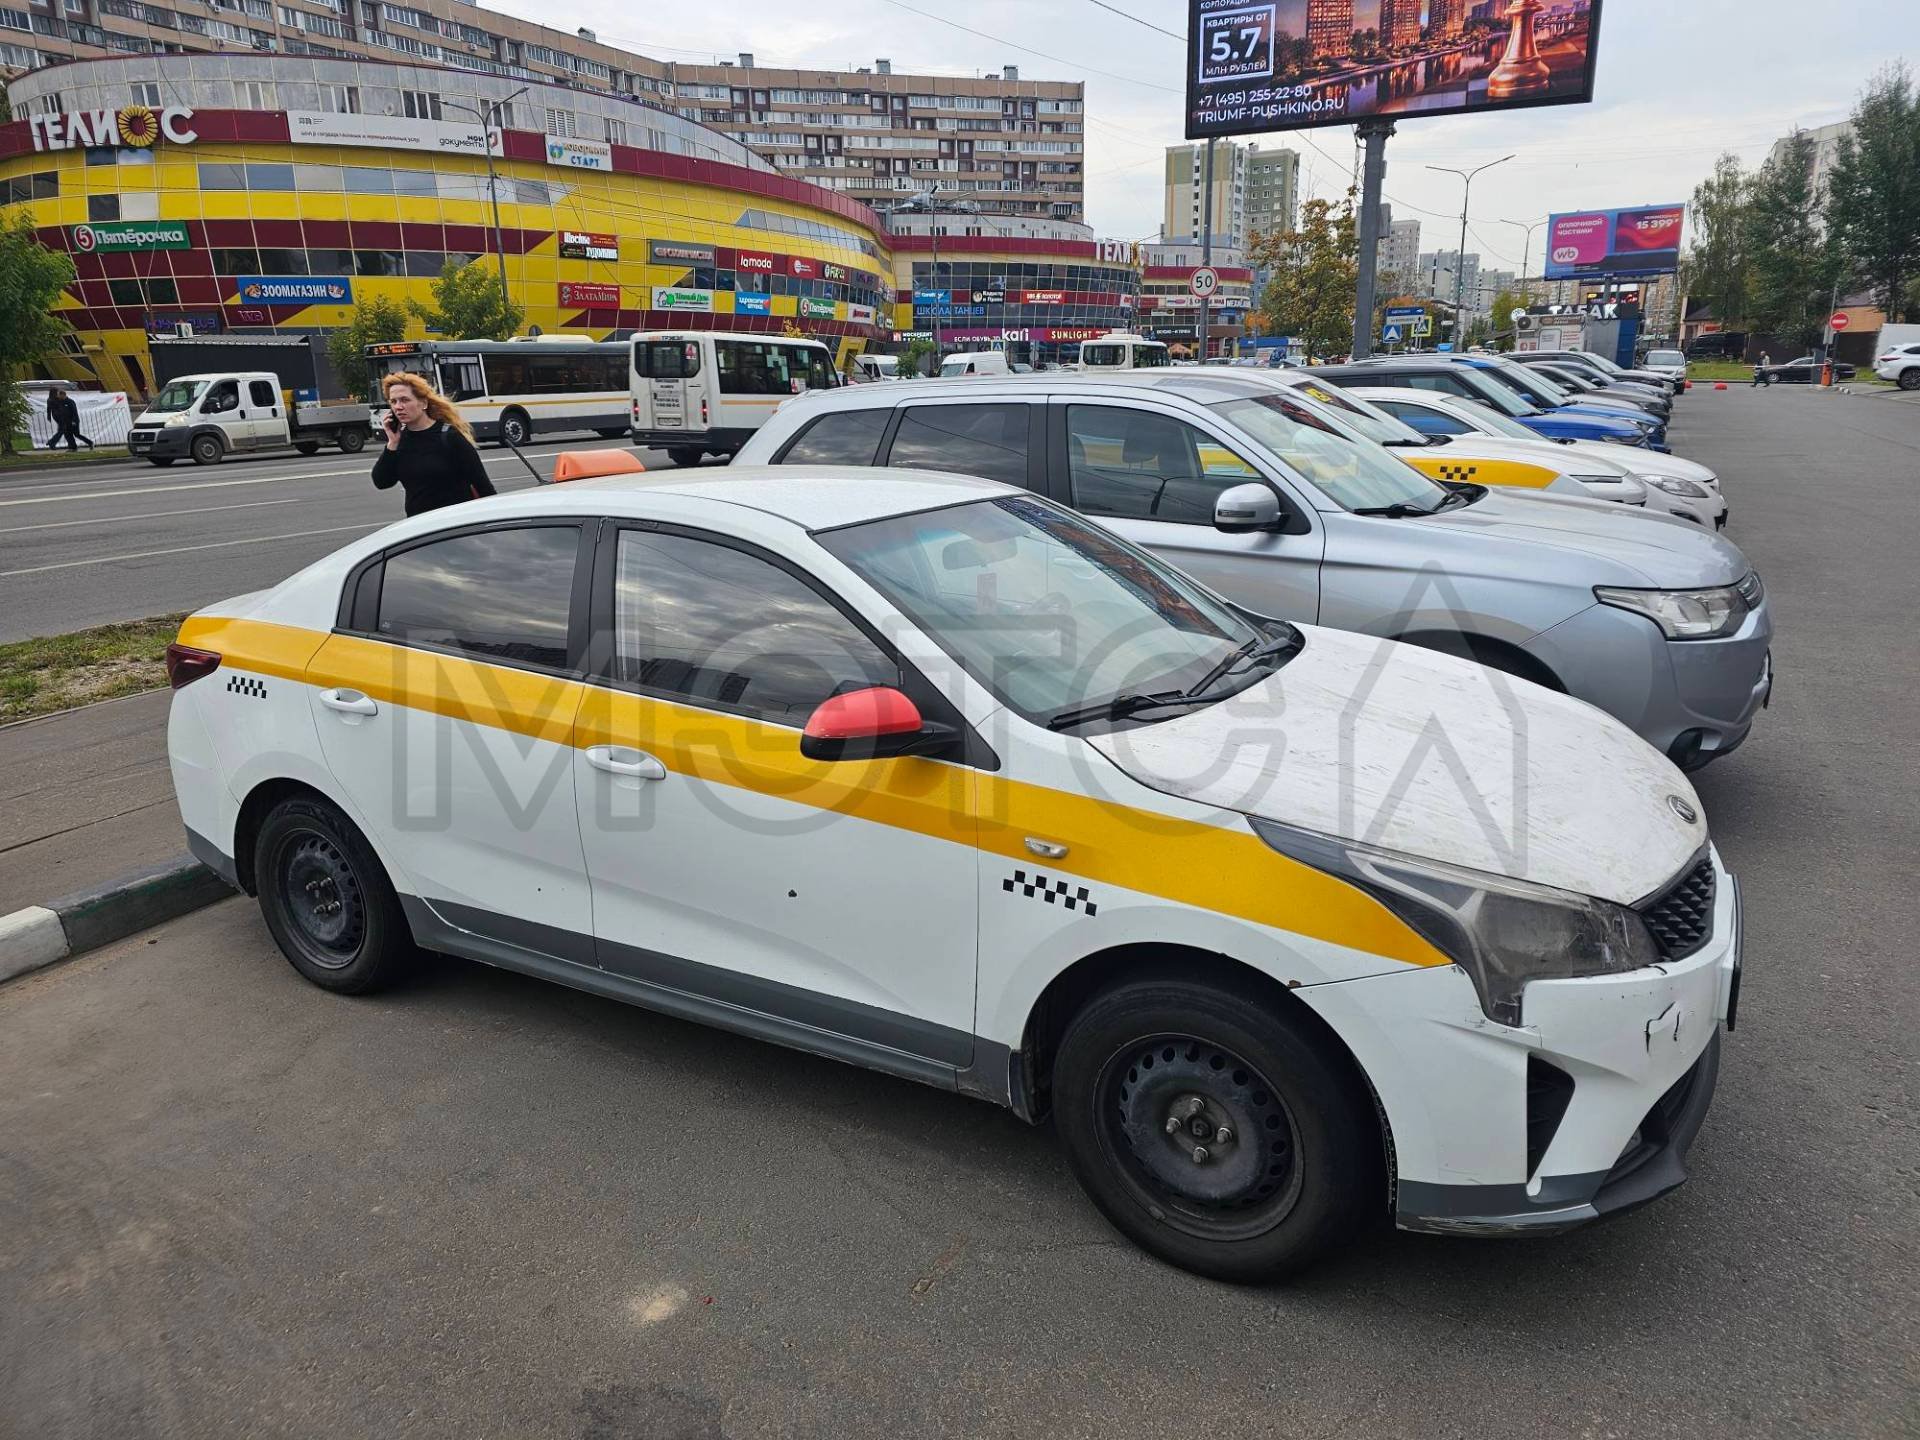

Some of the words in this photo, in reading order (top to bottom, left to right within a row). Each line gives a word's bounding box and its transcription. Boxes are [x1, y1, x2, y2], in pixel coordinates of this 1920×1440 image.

[1207, 15, 1254, 28] КВАРТИРЫ
[1255, 13, 1268, 22] ОТ
[1210, 27, 1263, 62] 5.7
[1206, 66, 1227, 76] МЛН
[1229, 58, 1267, 74] РУБЛЕЙ
[1198, 95, 1213, 107] +7
[1215, 90, 1246, 107] (495)
[1248, 84, 1312, 102] 255-22-80
[1198, 97, 1345, 123] TRIUMF-PUSHKINO.RU
[29, 105, 198, 151] ГЕЛИОС
[570, 155, 600, 168] СТАРТ
[1636, 220, 1649, 230] 15
[1650, 218, 1673, 228] 399
[95, 228, 185, 247] Пятёрочка
[740, 254, 772, 269] lamoda
[1556, 249, 1576, 260] wb
[1195, 276, 1213, 288] 50
[261, 284, 327, 297] ЗООМАГАЗИН
[916, 306, 950, 316] ШКОЛА
[953, 306, 985, 316] ТАНЦЕВ
[1548, 303, 1618, 320] ТАБАК
[1001, 328, 1029, 342] kari
[1051, 330, 1092, 340] SUNLIGHT
